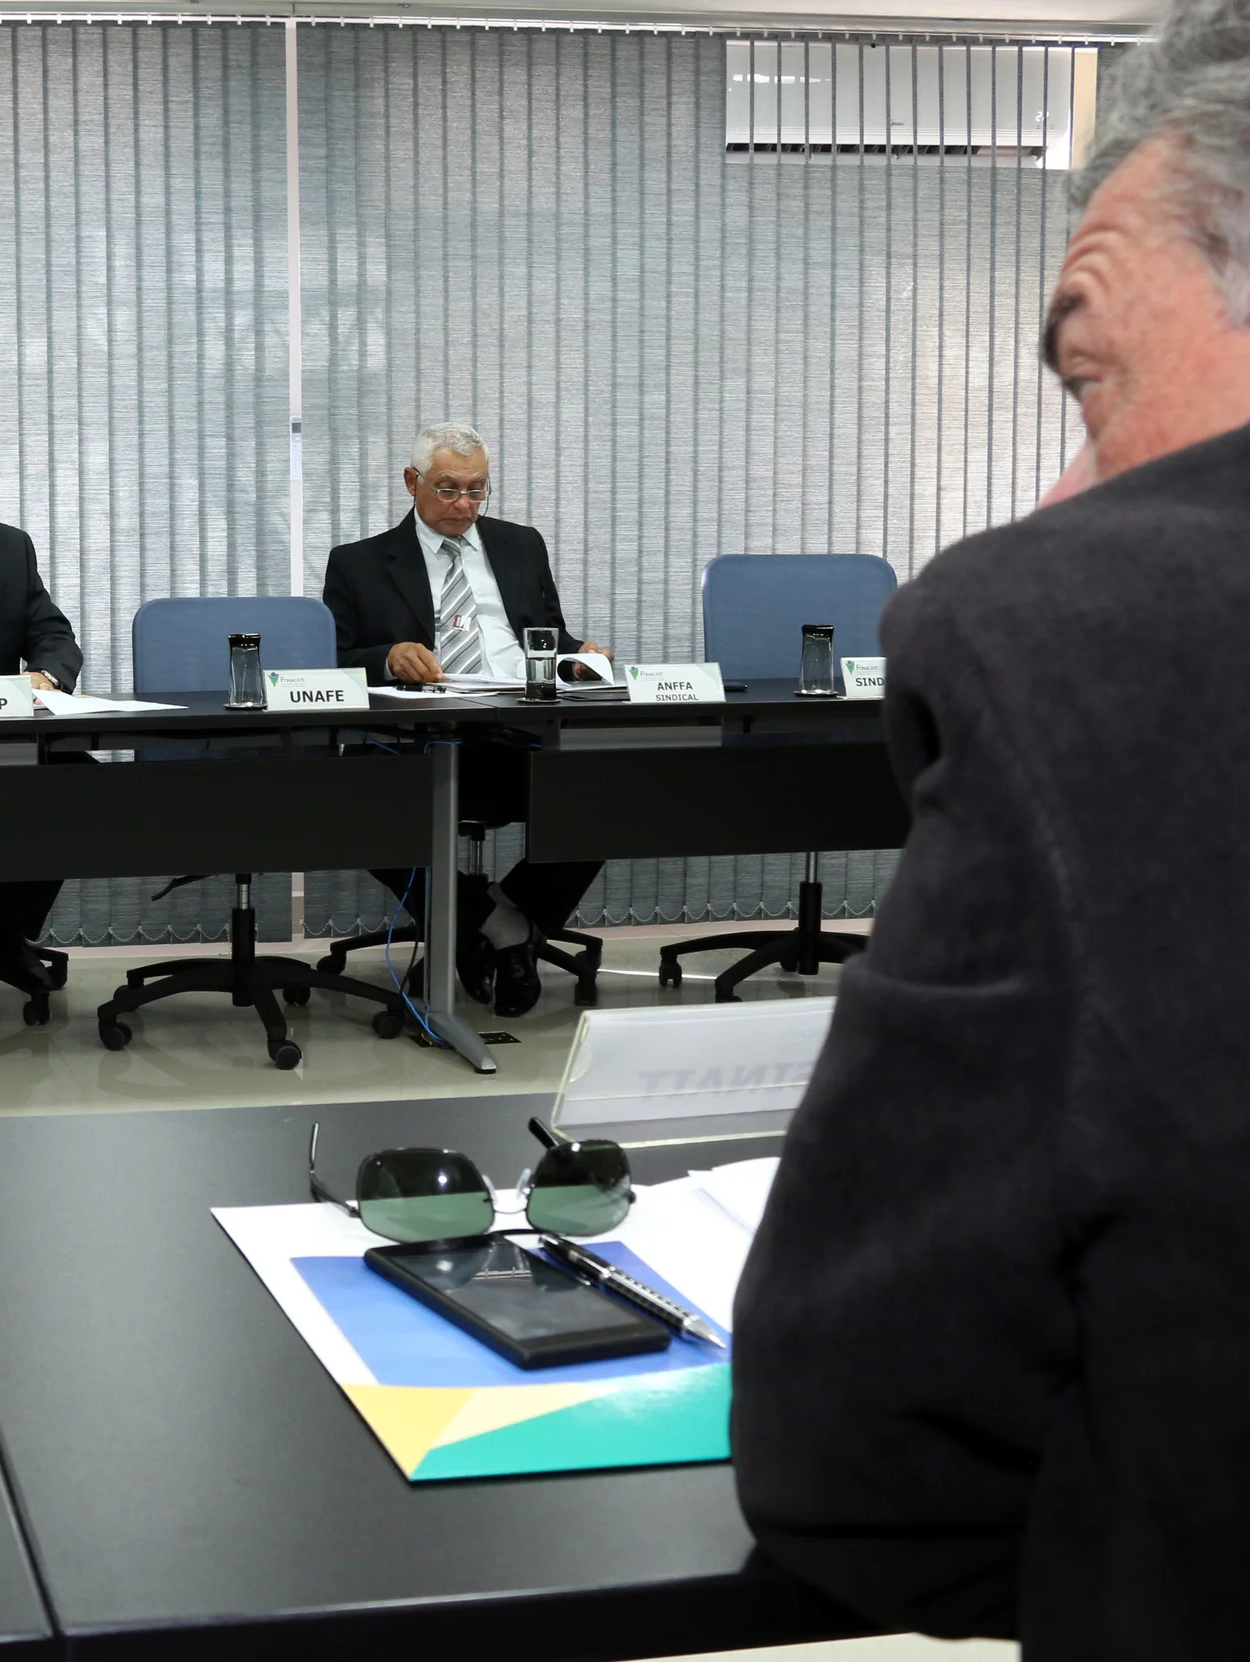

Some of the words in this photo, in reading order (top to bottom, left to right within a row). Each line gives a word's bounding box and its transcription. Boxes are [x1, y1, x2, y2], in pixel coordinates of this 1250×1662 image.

[657, 682, 693, 691] ANFFA
[855, 677, 885, 687] SIND
[290, 690, 344, 703] UNAFE
[655, 694, 699, 702] SINDICAL
